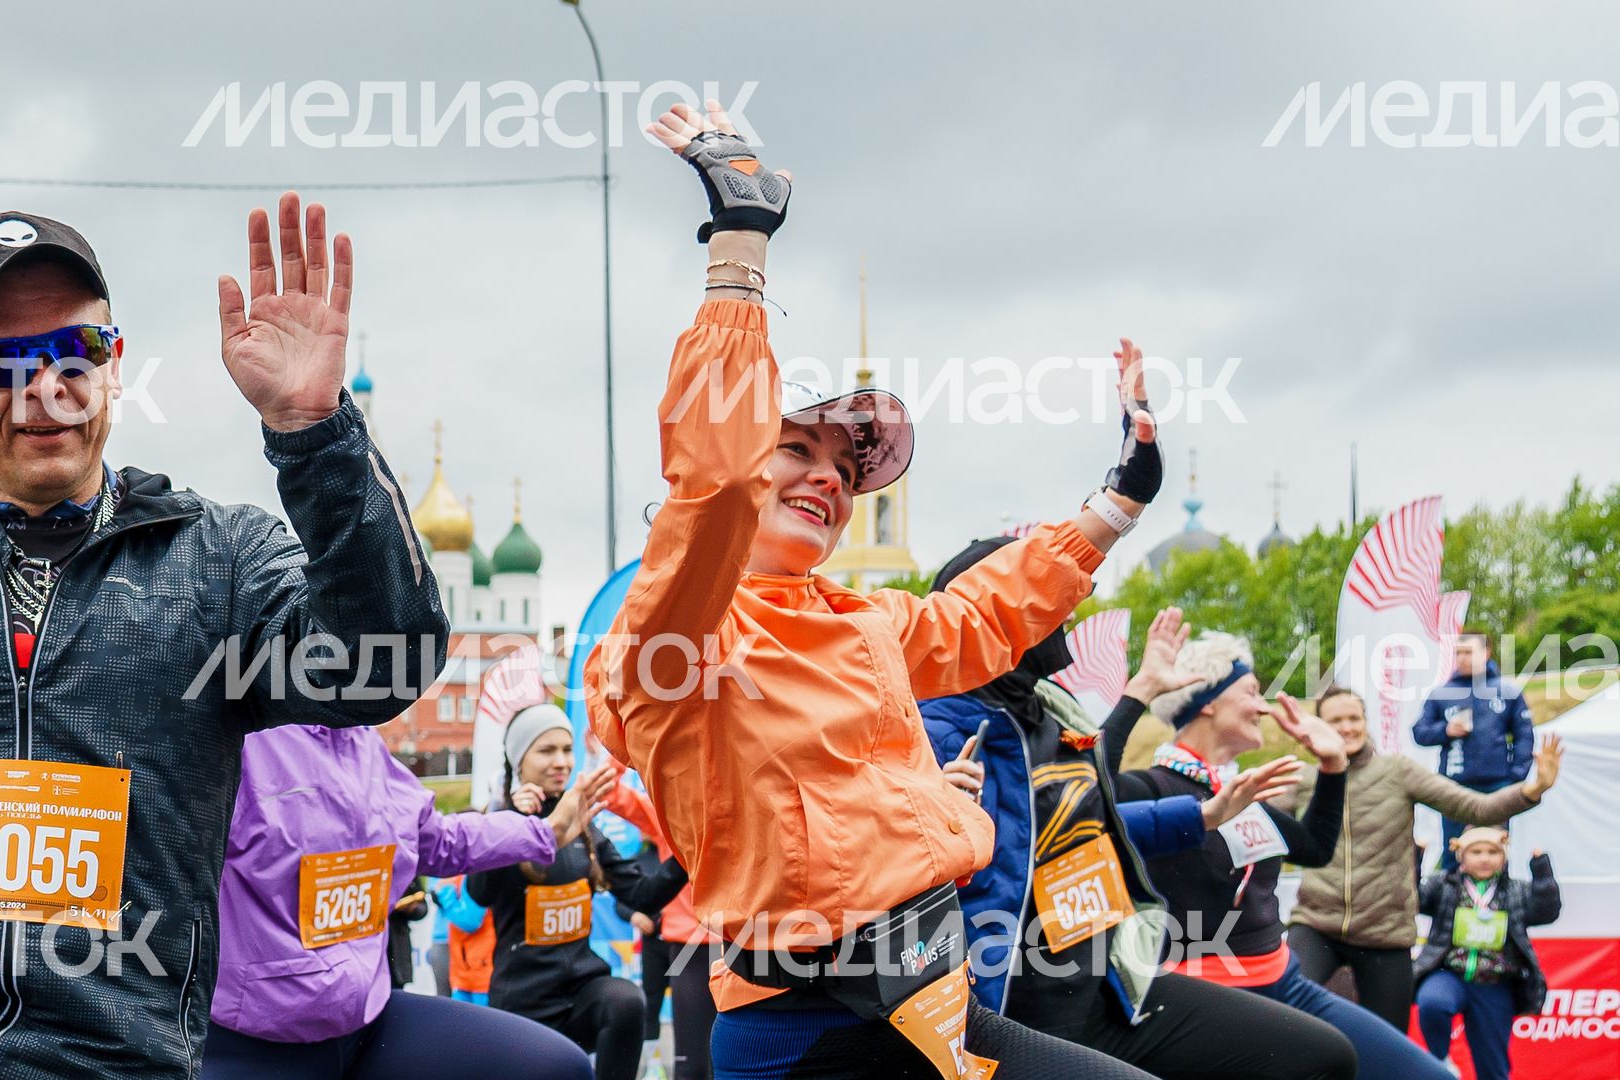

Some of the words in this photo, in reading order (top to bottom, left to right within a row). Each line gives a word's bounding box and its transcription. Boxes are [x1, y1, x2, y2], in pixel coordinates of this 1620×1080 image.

[42, 803, 122, 822] ПОЛУМАРАФОН
[313, 882, 372, 930] 5265
[1052, 875, 1110, 930] 5251
[543, 904, 583, 935] 5101
[1541, 989, 1620, 1016] ПЕР
[1511, 1016, 1620, 1042] ОДМОС
